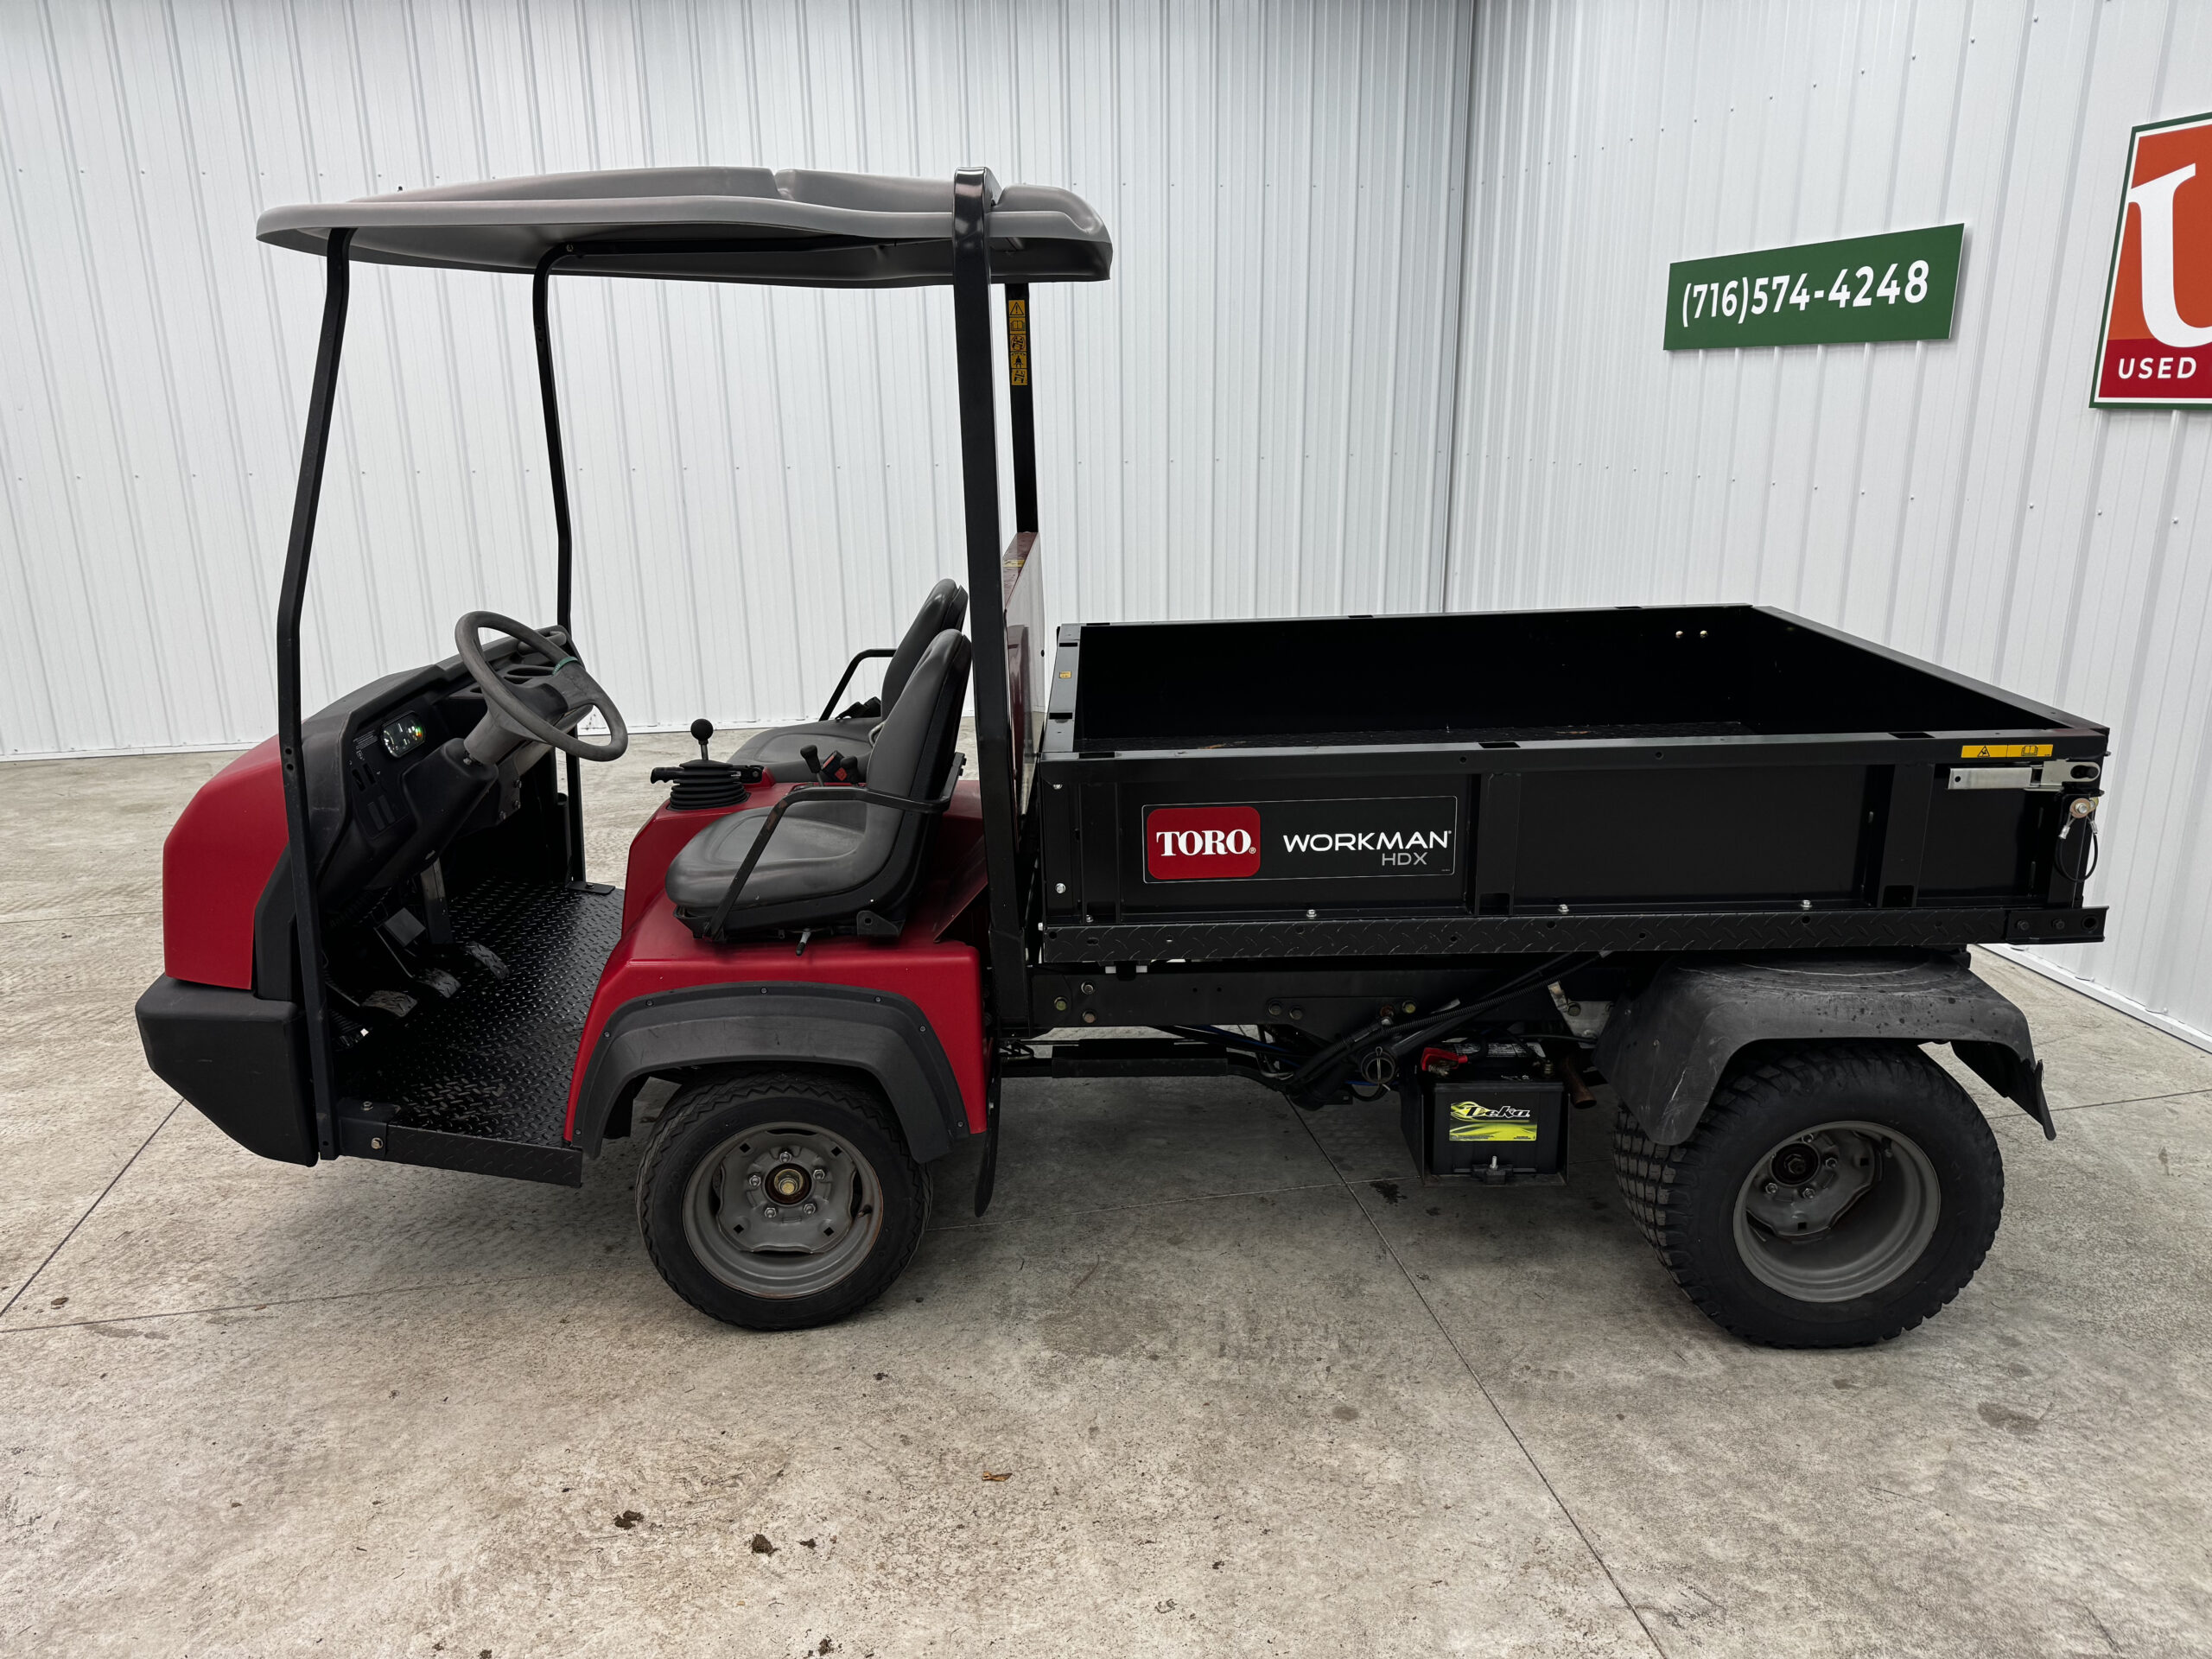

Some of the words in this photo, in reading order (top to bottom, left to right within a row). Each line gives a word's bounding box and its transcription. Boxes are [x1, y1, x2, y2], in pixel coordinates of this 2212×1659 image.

[1682, 259, 1929, 327] (716)574-4248
[2118, 356, 2197, 379] USED
[1282, 830, 1448, 853] WORKMAN
[1382, 852, 1428, 867] HDX
